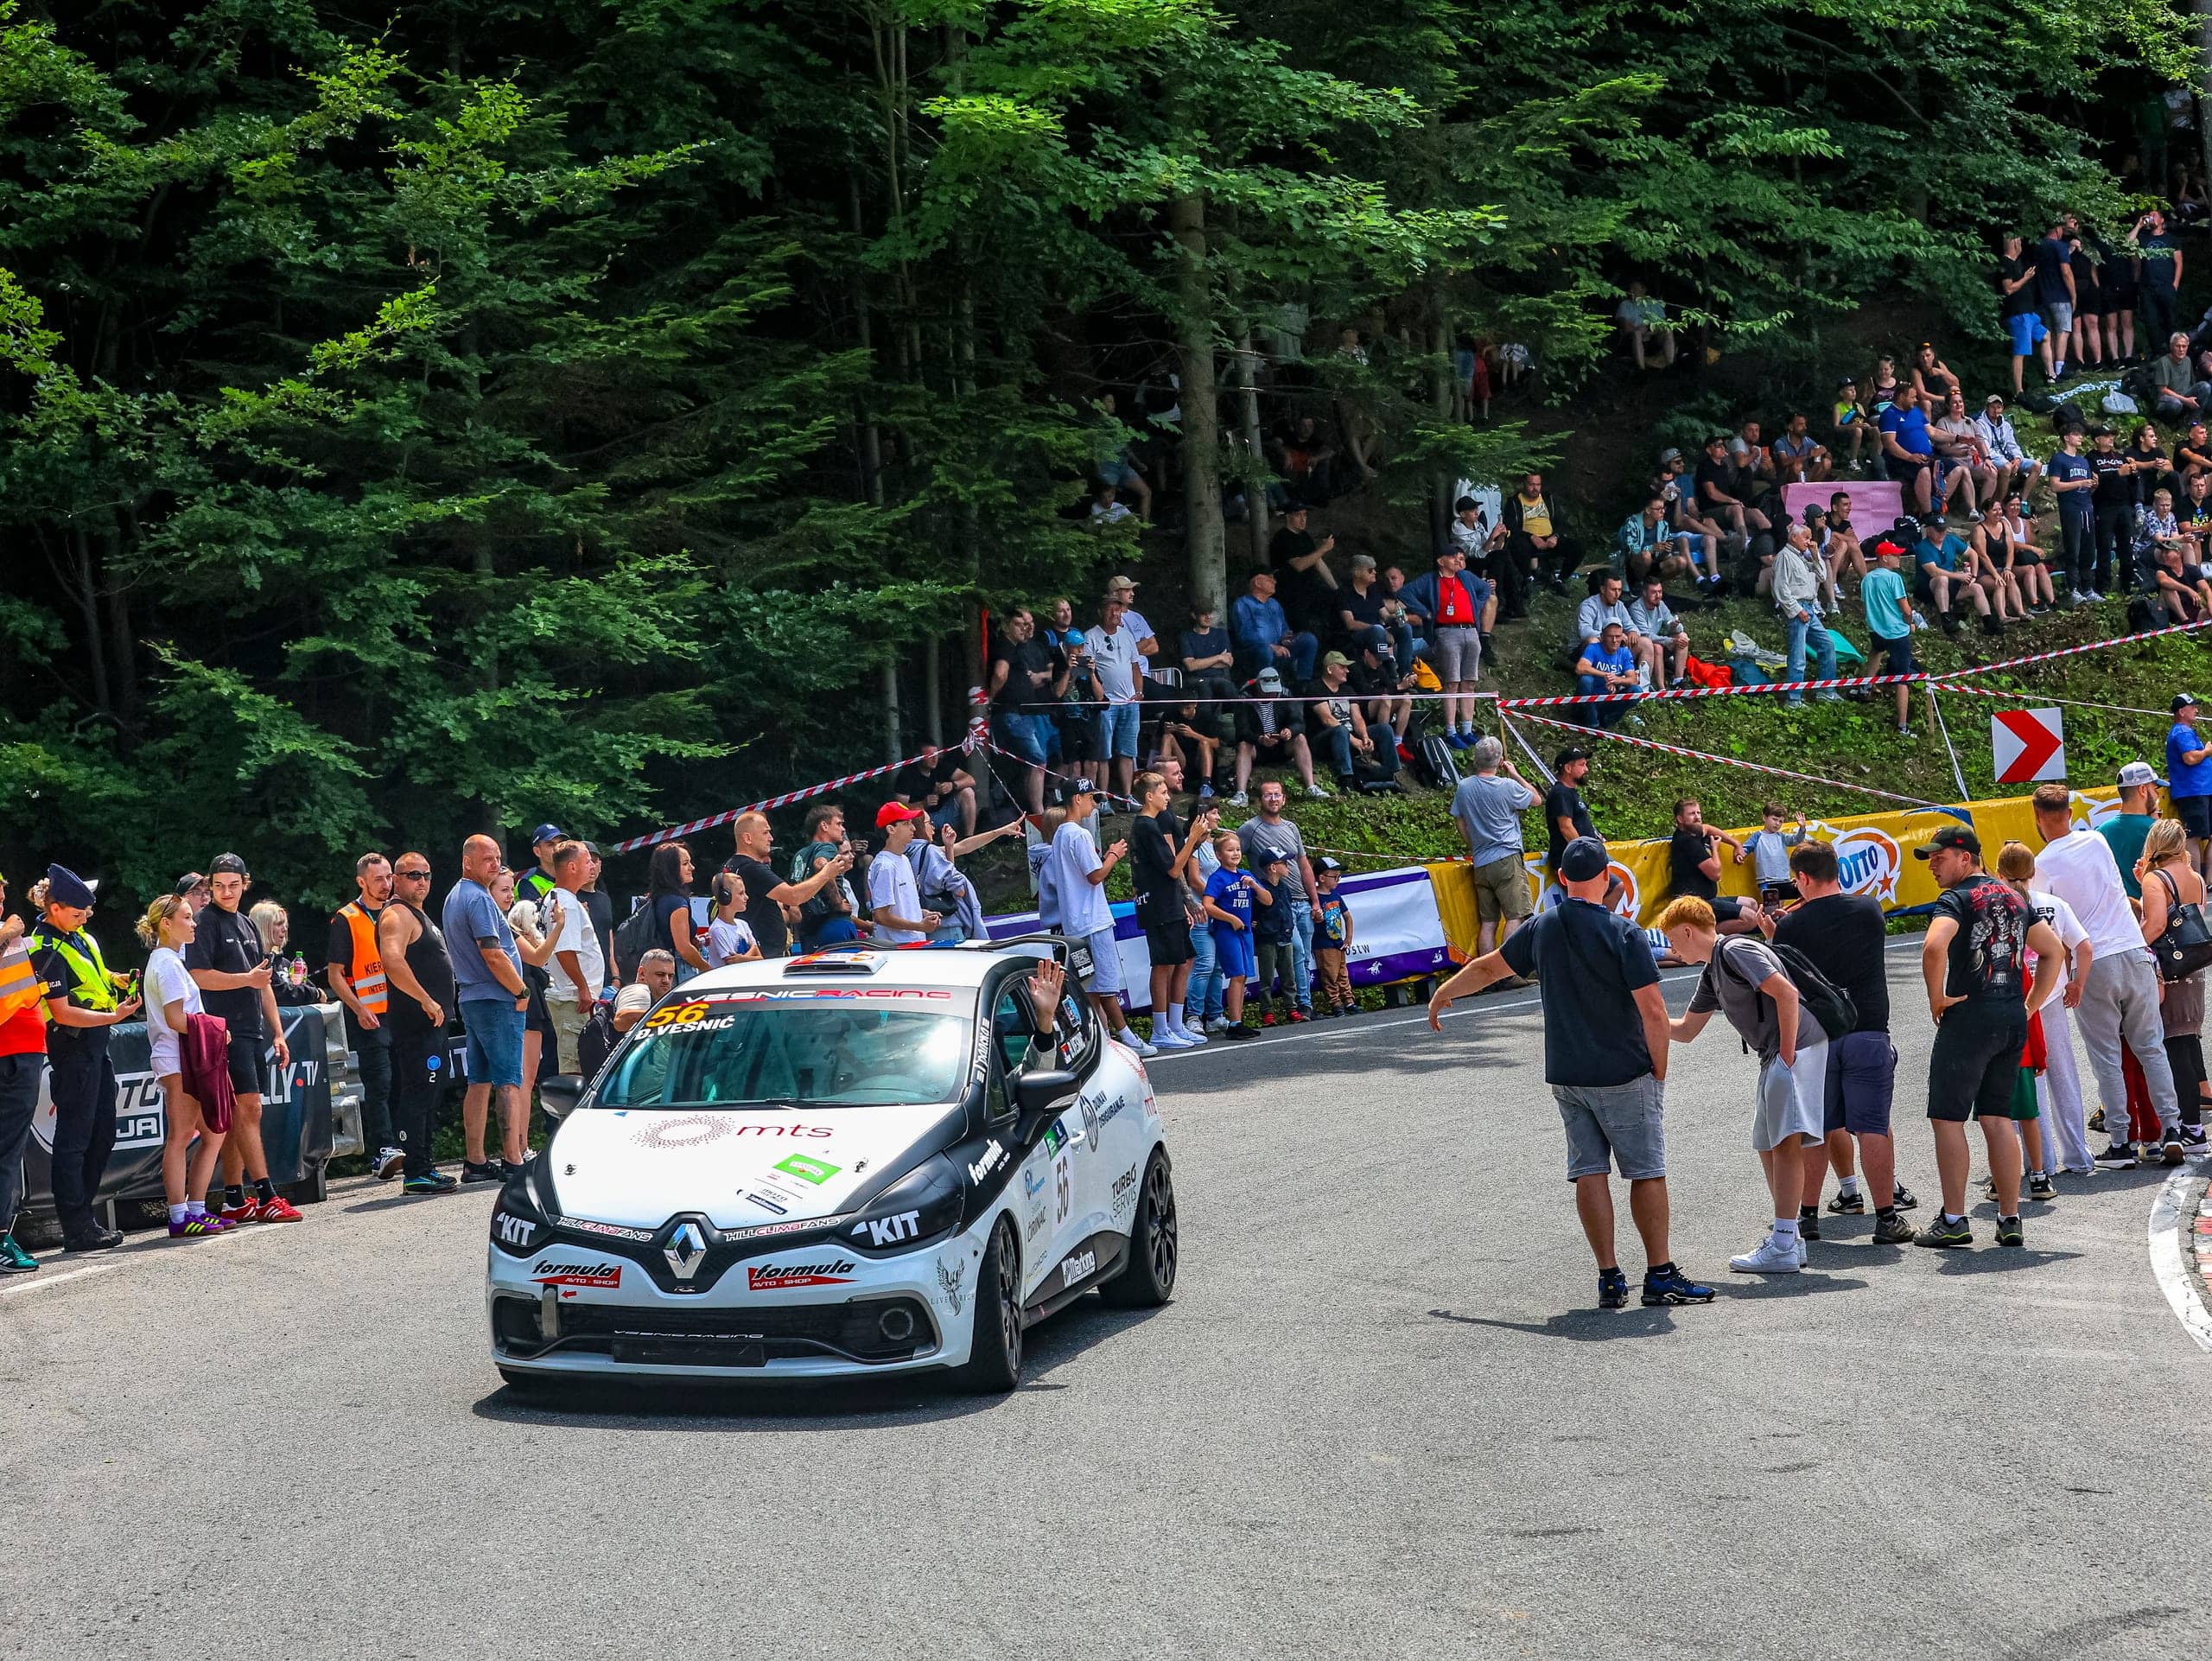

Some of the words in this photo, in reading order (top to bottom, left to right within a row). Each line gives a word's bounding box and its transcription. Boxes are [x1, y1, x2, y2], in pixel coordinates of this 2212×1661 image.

[1596, 661, 1624, 674] NASA
[1838, 845, 1878, 889] OTTO
[1232, 899, 1249, 908] EVER
[364, 961, 383, 976] KIER
[48, 980, 62, 989] ICJA
[645, 1002, 709, 1028] 56
[117, 1117, 157, 1139] JA
[736, 1124, 834, 1138] mts
[1111, 1161, 1137, 1196] TURBO
[1056, 1155, 1070, 1225] 56
[500, 1213, 537, 1246] KIT
[868, 1209, 920, 1246] KIT
[531, 1260, 616, 1277] formula
[754, 1259, 857, 1281] formula
[784, 1277, 812, 1286] SHOP
